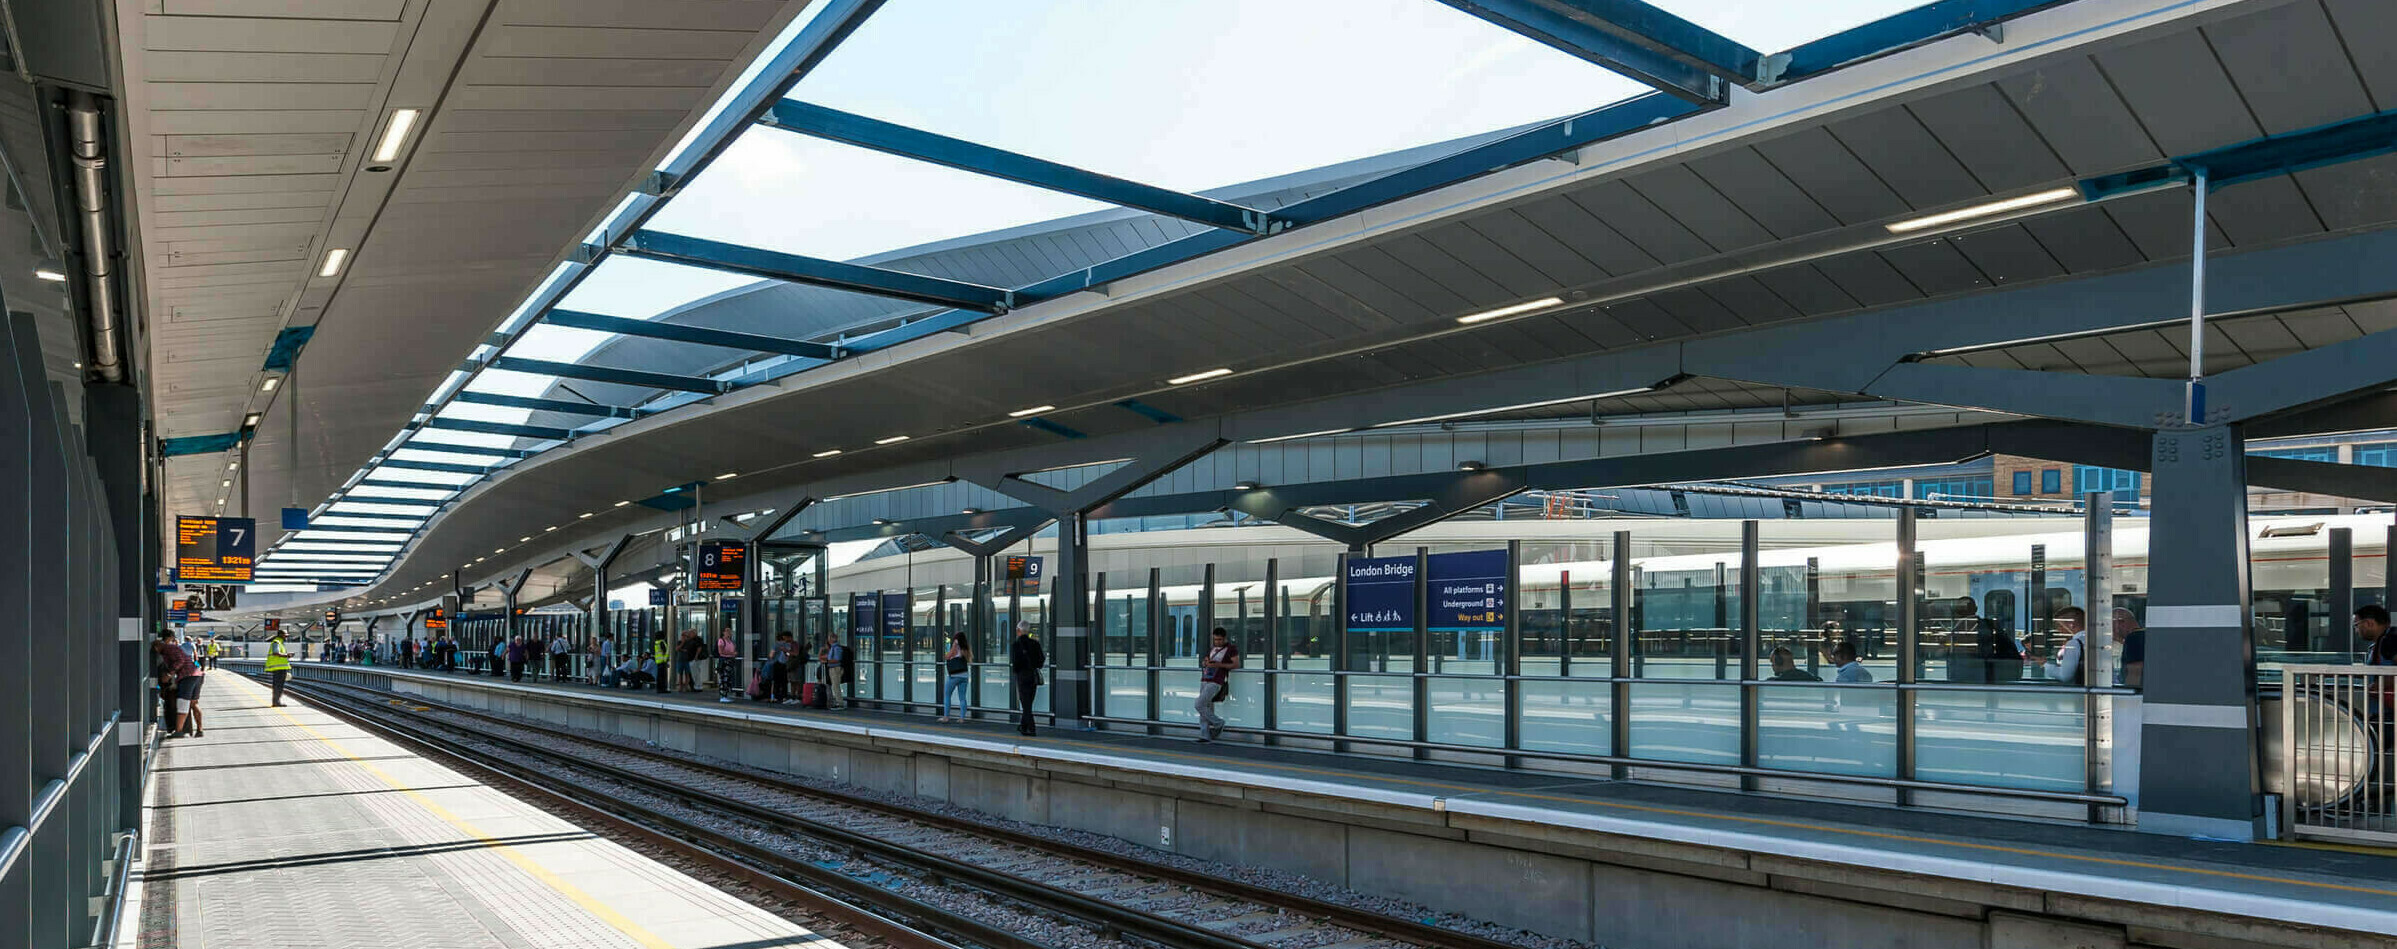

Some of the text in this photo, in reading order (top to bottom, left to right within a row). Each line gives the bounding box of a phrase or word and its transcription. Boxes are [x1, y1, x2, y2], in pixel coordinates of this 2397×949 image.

[229, 528, 245, 546] 7
[705, 553, 714, 566] 8
[1030, 563, 1038, 575] 9
[1350, 564, 1413, 577] London Bridge
[1453, 586, 1484, 595] platforms
[1443, 600, 1484, 609] Underground
[1360, 612, 1374, 622] Lift
[1458, 614, 1471, 623] Way
